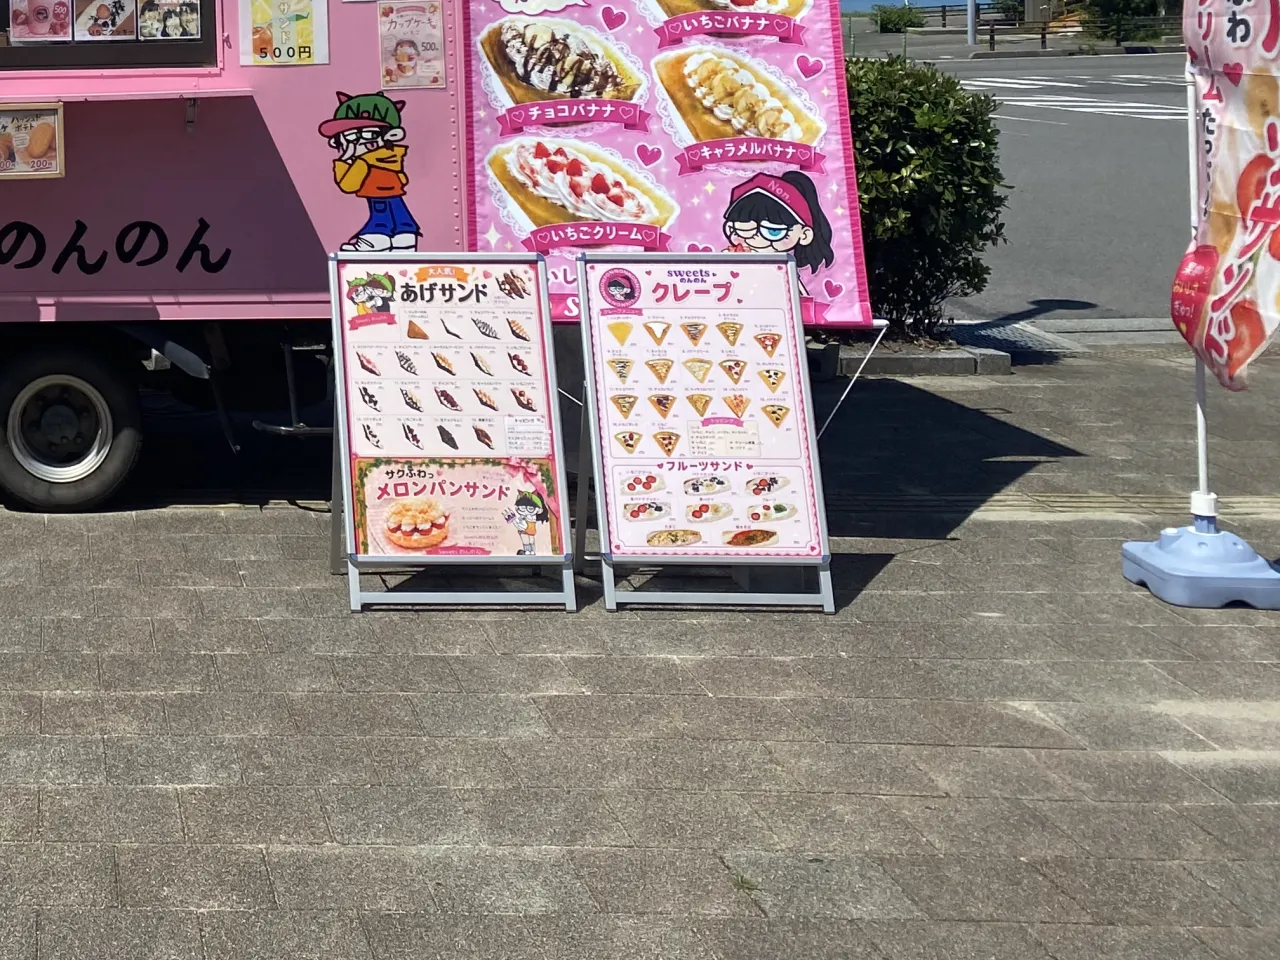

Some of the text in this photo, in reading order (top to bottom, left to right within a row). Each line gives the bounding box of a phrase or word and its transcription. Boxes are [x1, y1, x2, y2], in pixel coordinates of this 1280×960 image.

[682, 16, 770, 31] いちごバナナ
[528, 103, 616, 120] チョコバナナ
[15, 123, 34, 132] ポテト
[701, 144, 797, 161] キャラメルバナナ
[551, 224, 643, 241] いちごクリーム
[668, 269, 710, 277] sweets
[401, 282, 488, 303] あげサンド
[652, 282, 731, 303] クレープ
[385, 469, 434, 480] サクふわっ
[666, 461, 743, 472] フルーツサンド
[377, 480, 511, 501] メロンパンサンド
